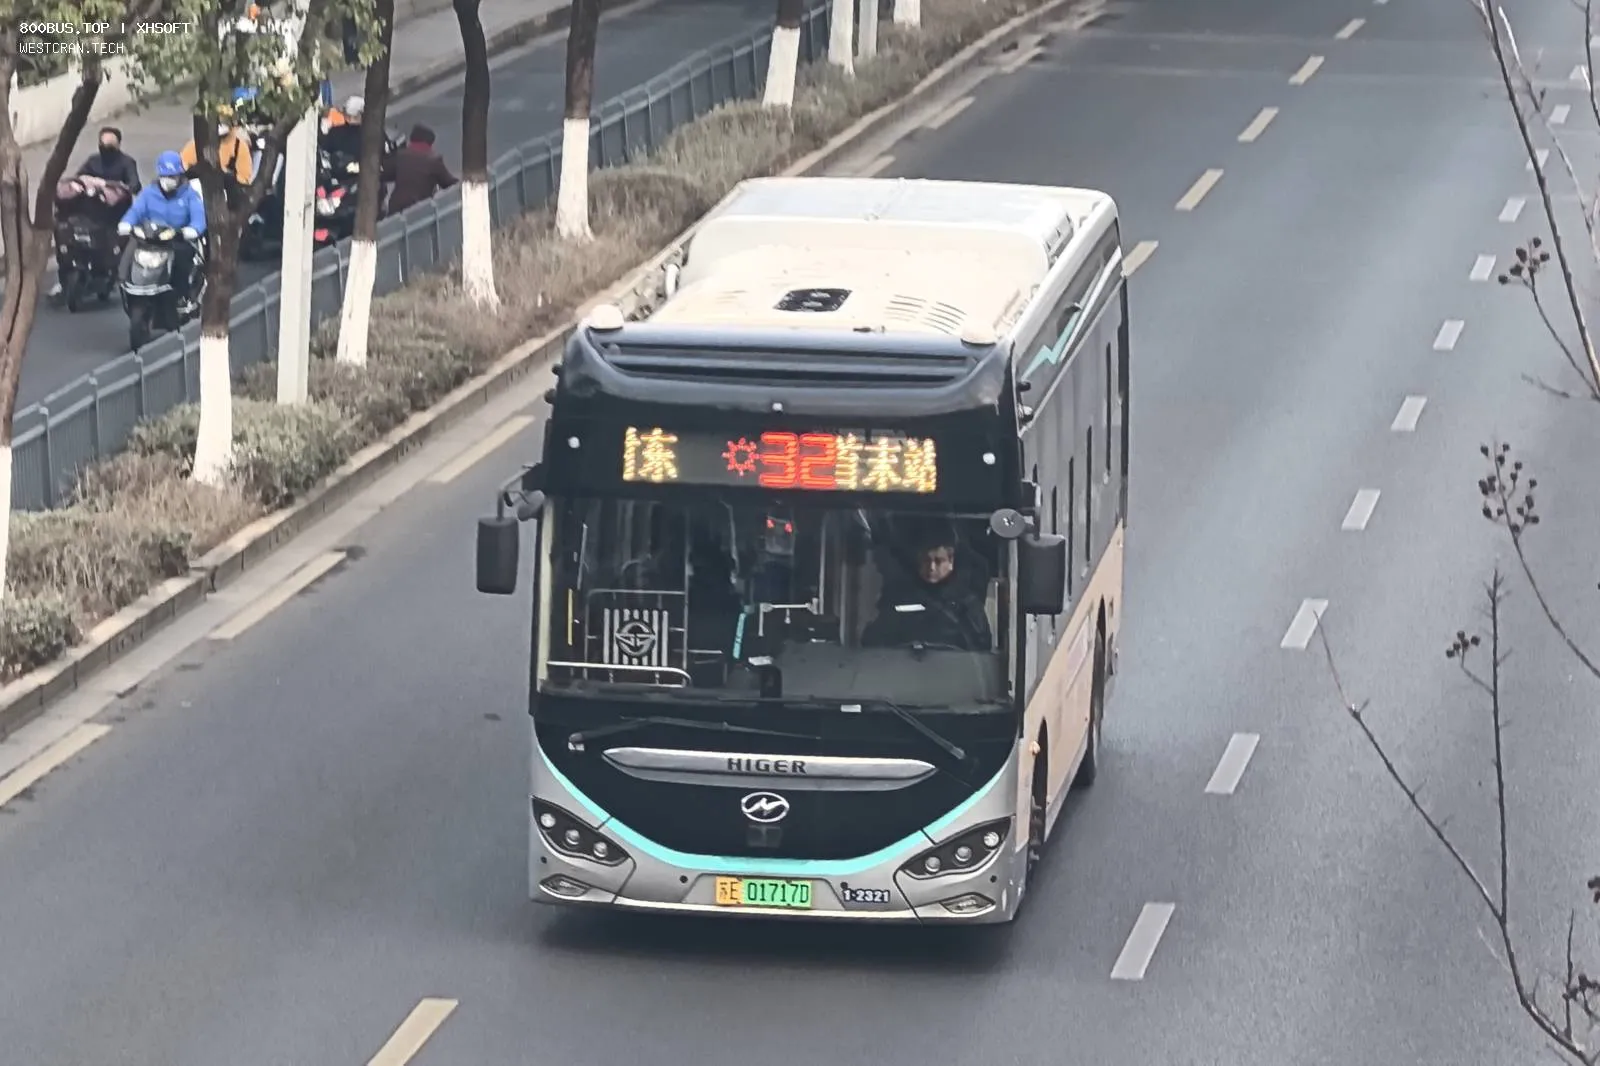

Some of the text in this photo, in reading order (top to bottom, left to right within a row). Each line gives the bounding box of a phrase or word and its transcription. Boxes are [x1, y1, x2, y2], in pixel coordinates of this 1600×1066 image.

[760, 432, 836, 489] 32
[727, 757, 808, 774] HIGER
[746, 882, 810, 903] 01717D
